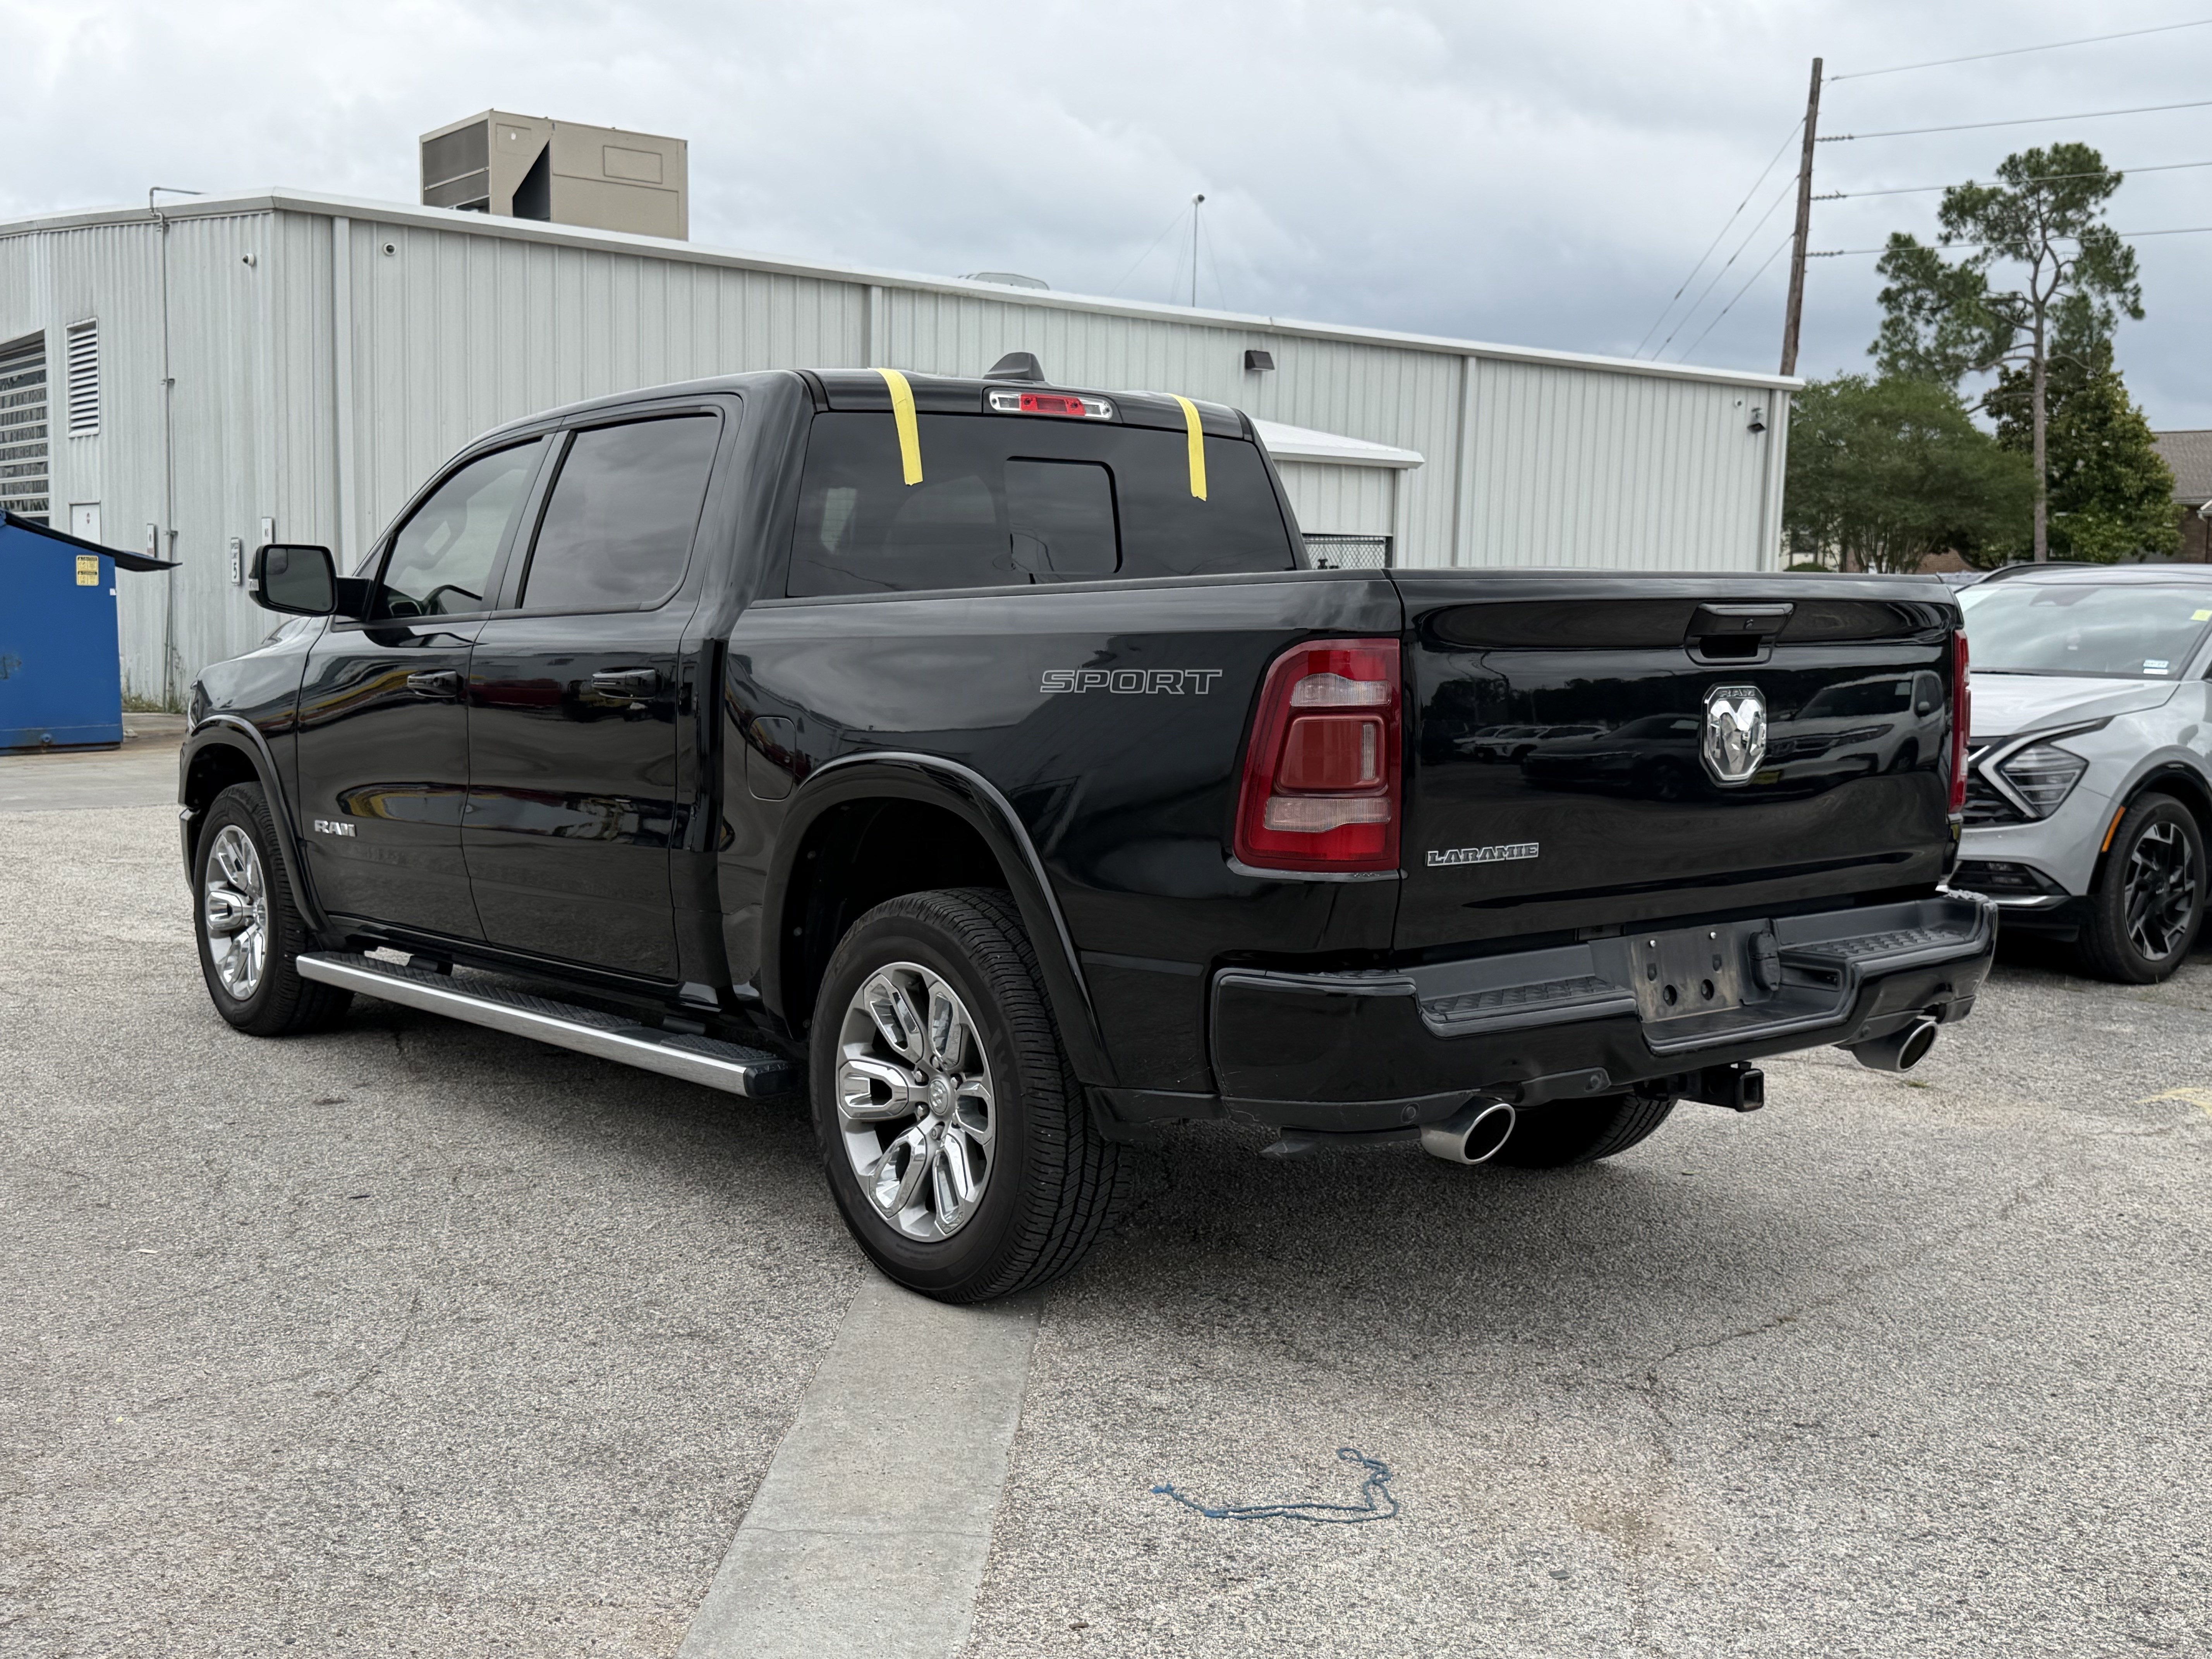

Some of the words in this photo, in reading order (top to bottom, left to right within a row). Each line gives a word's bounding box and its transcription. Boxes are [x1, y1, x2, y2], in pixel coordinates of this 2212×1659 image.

[1040, 669, 1223, 694] SPORT
[314, 819, 356, 837] RAM
[1427, 843, 1539, 866] LARAMIE
